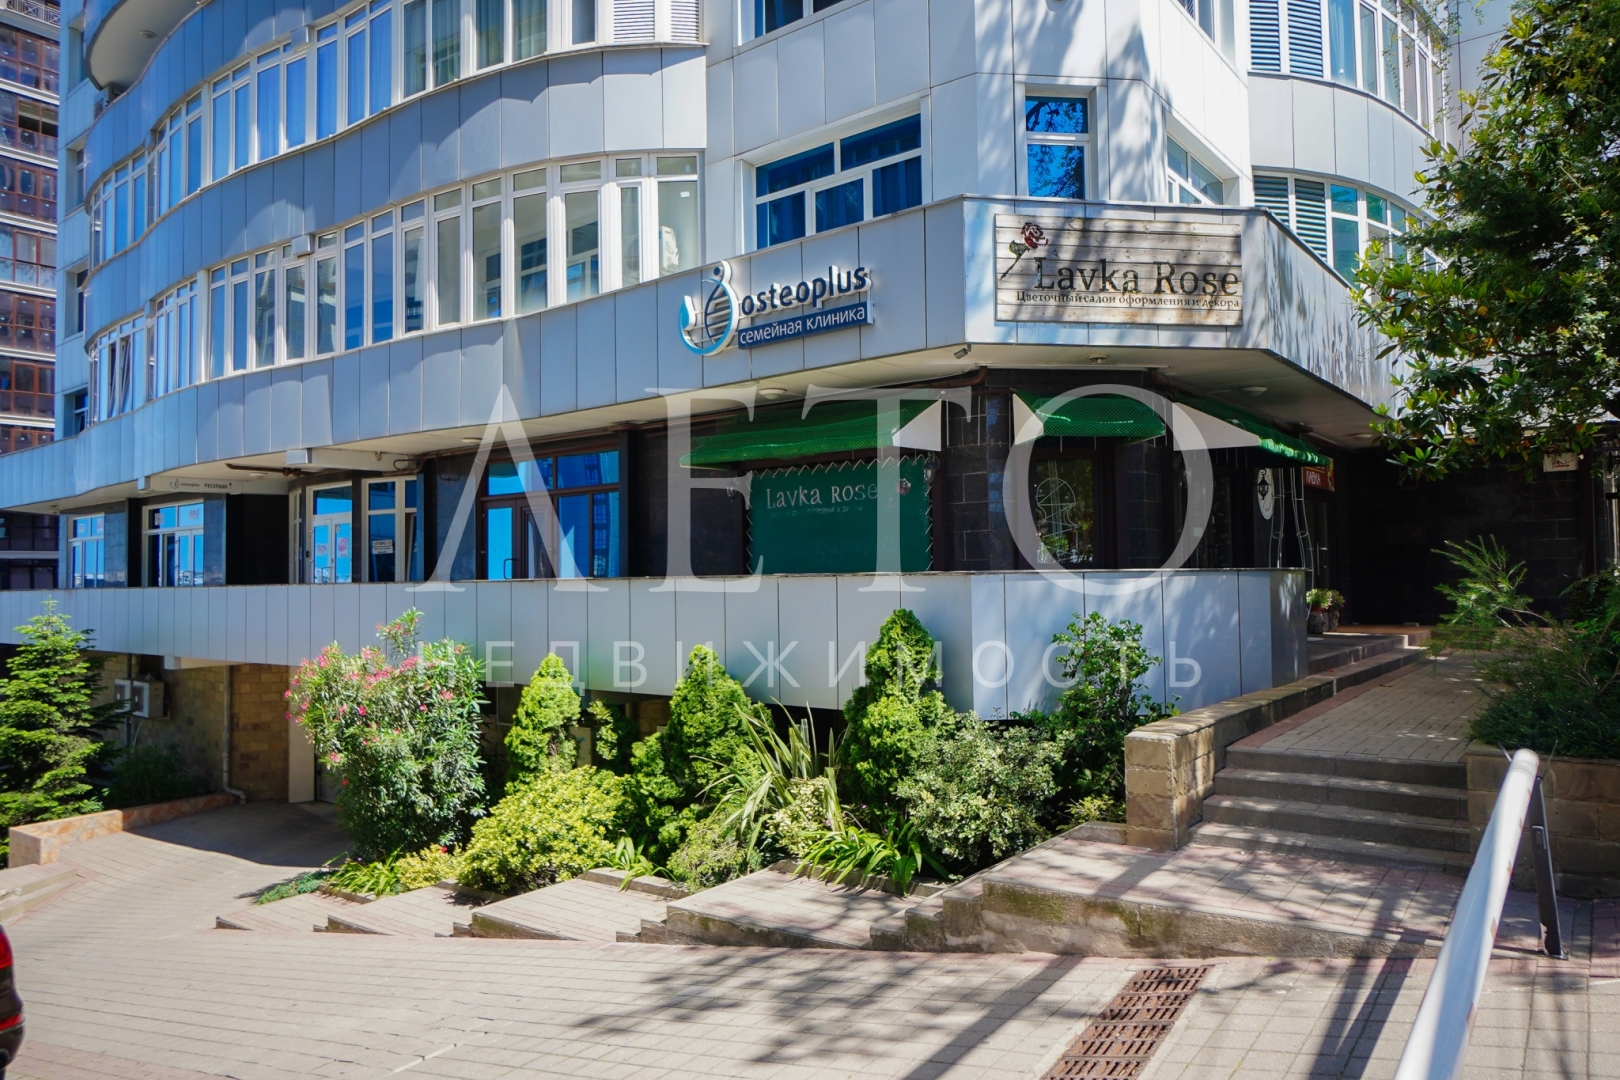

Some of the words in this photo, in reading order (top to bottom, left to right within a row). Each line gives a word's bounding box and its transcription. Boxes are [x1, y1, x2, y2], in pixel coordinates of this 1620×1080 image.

[742, 265, 869, 309] osteoplus
[1034, 256, 1142, 293] Lavka
[1153, 260, 1239, 296] Rose
[1016, 290, 1082, 303] Цветочный
[1084, 294, 1116, 304] салон
[1119, 294, 1190, 308] оформления
[1202, 299, 1239, 310] декора
[740, 322, 802, 344] семейная
[806, 306, 865, 331] клиника
[766, 485, 822, 509] Lavka
